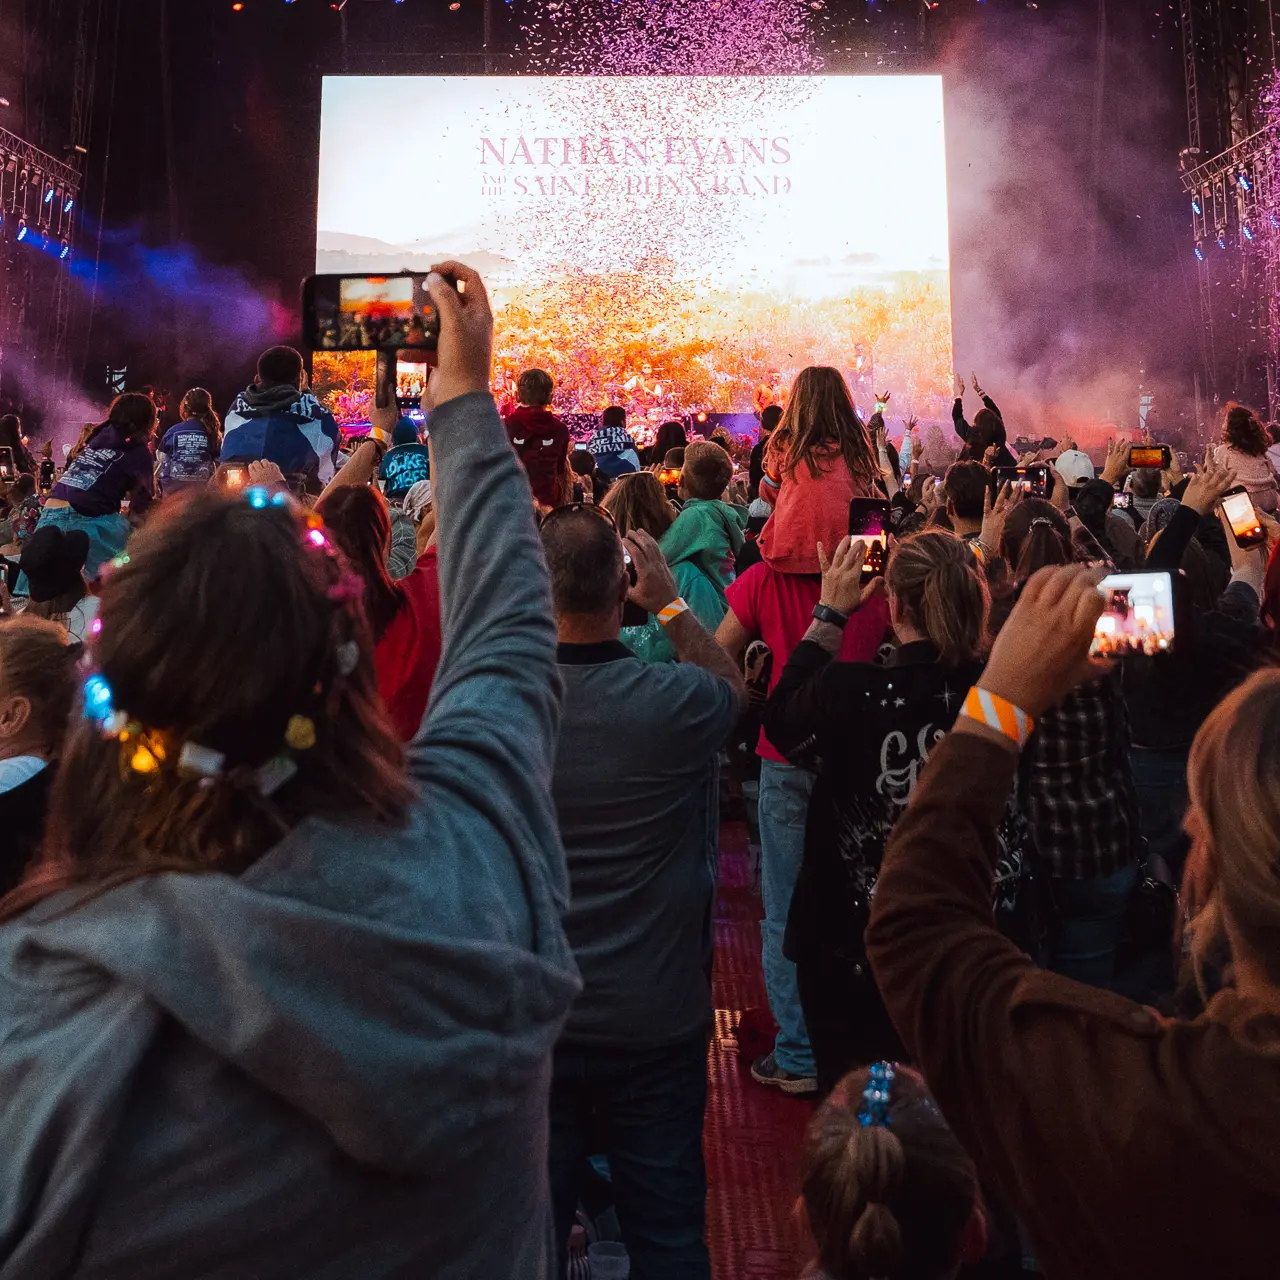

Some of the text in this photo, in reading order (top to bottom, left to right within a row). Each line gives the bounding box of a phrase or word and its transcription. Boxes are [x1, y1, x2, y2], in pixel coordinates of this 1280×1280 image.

[479, 136, 791, 166] NATHAN EVANS
[713, 175, 792, 196] BAND
